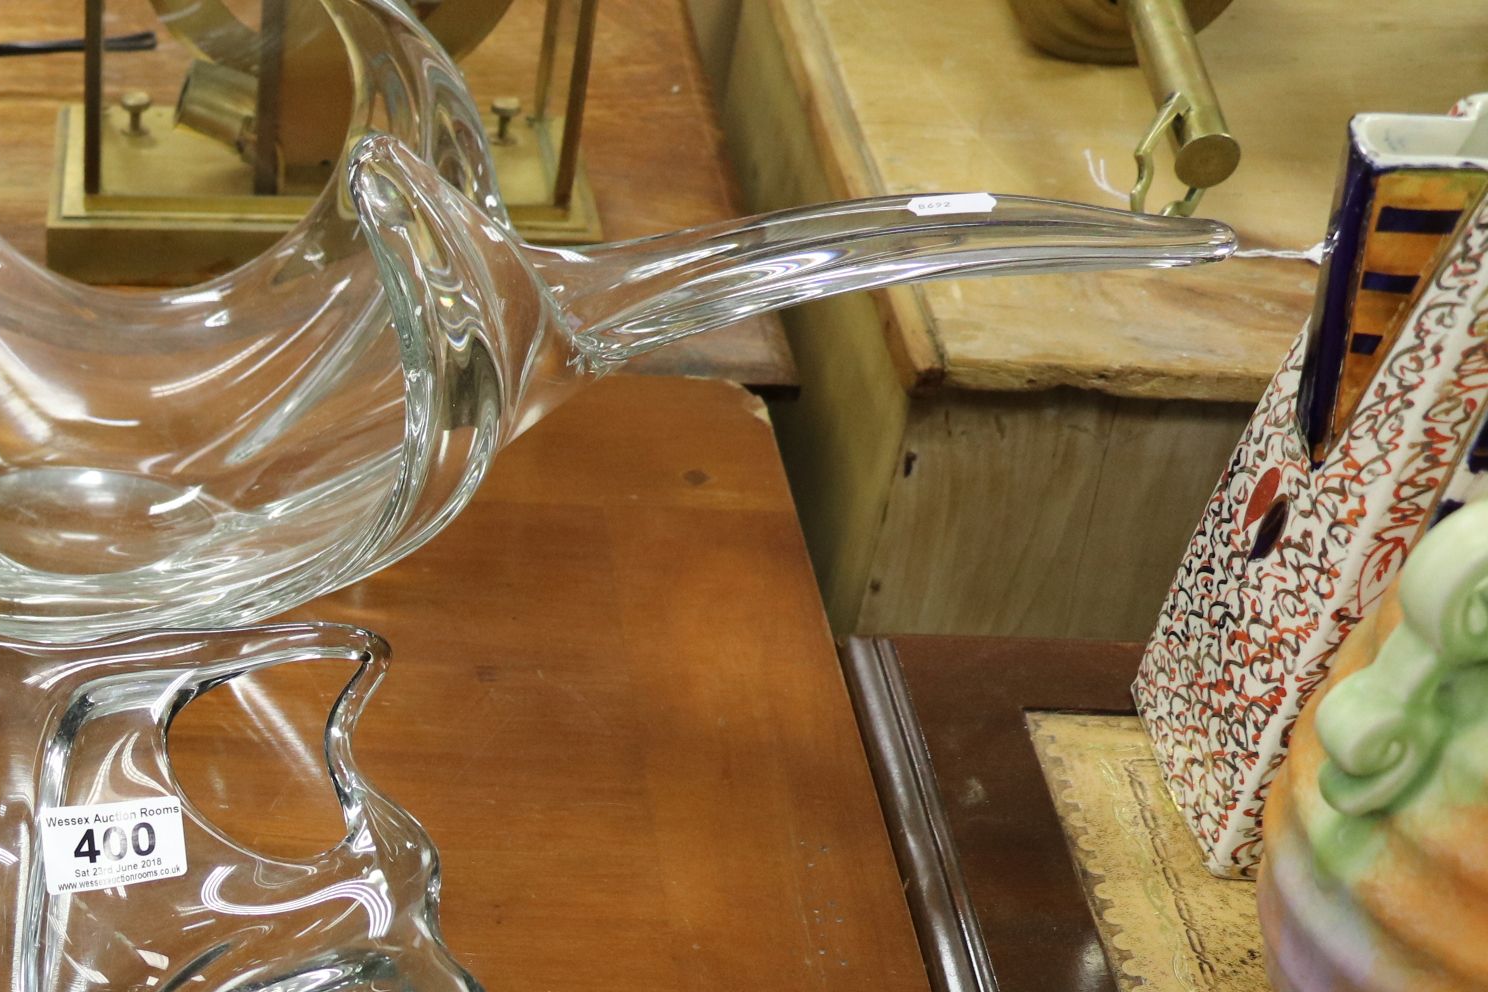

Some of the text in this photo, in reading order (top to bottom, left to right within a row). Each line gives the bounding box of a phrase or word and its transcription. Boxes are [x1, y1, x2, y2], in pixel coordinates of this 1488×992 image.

[45, 805, 180, 828] Wessex Auction Rooms
[74, 822, 157, 864] 400
[74, 869, 90, 878] Sat
[116, 863, 138, 873] June
[141, 857, 162, 869] 2018
